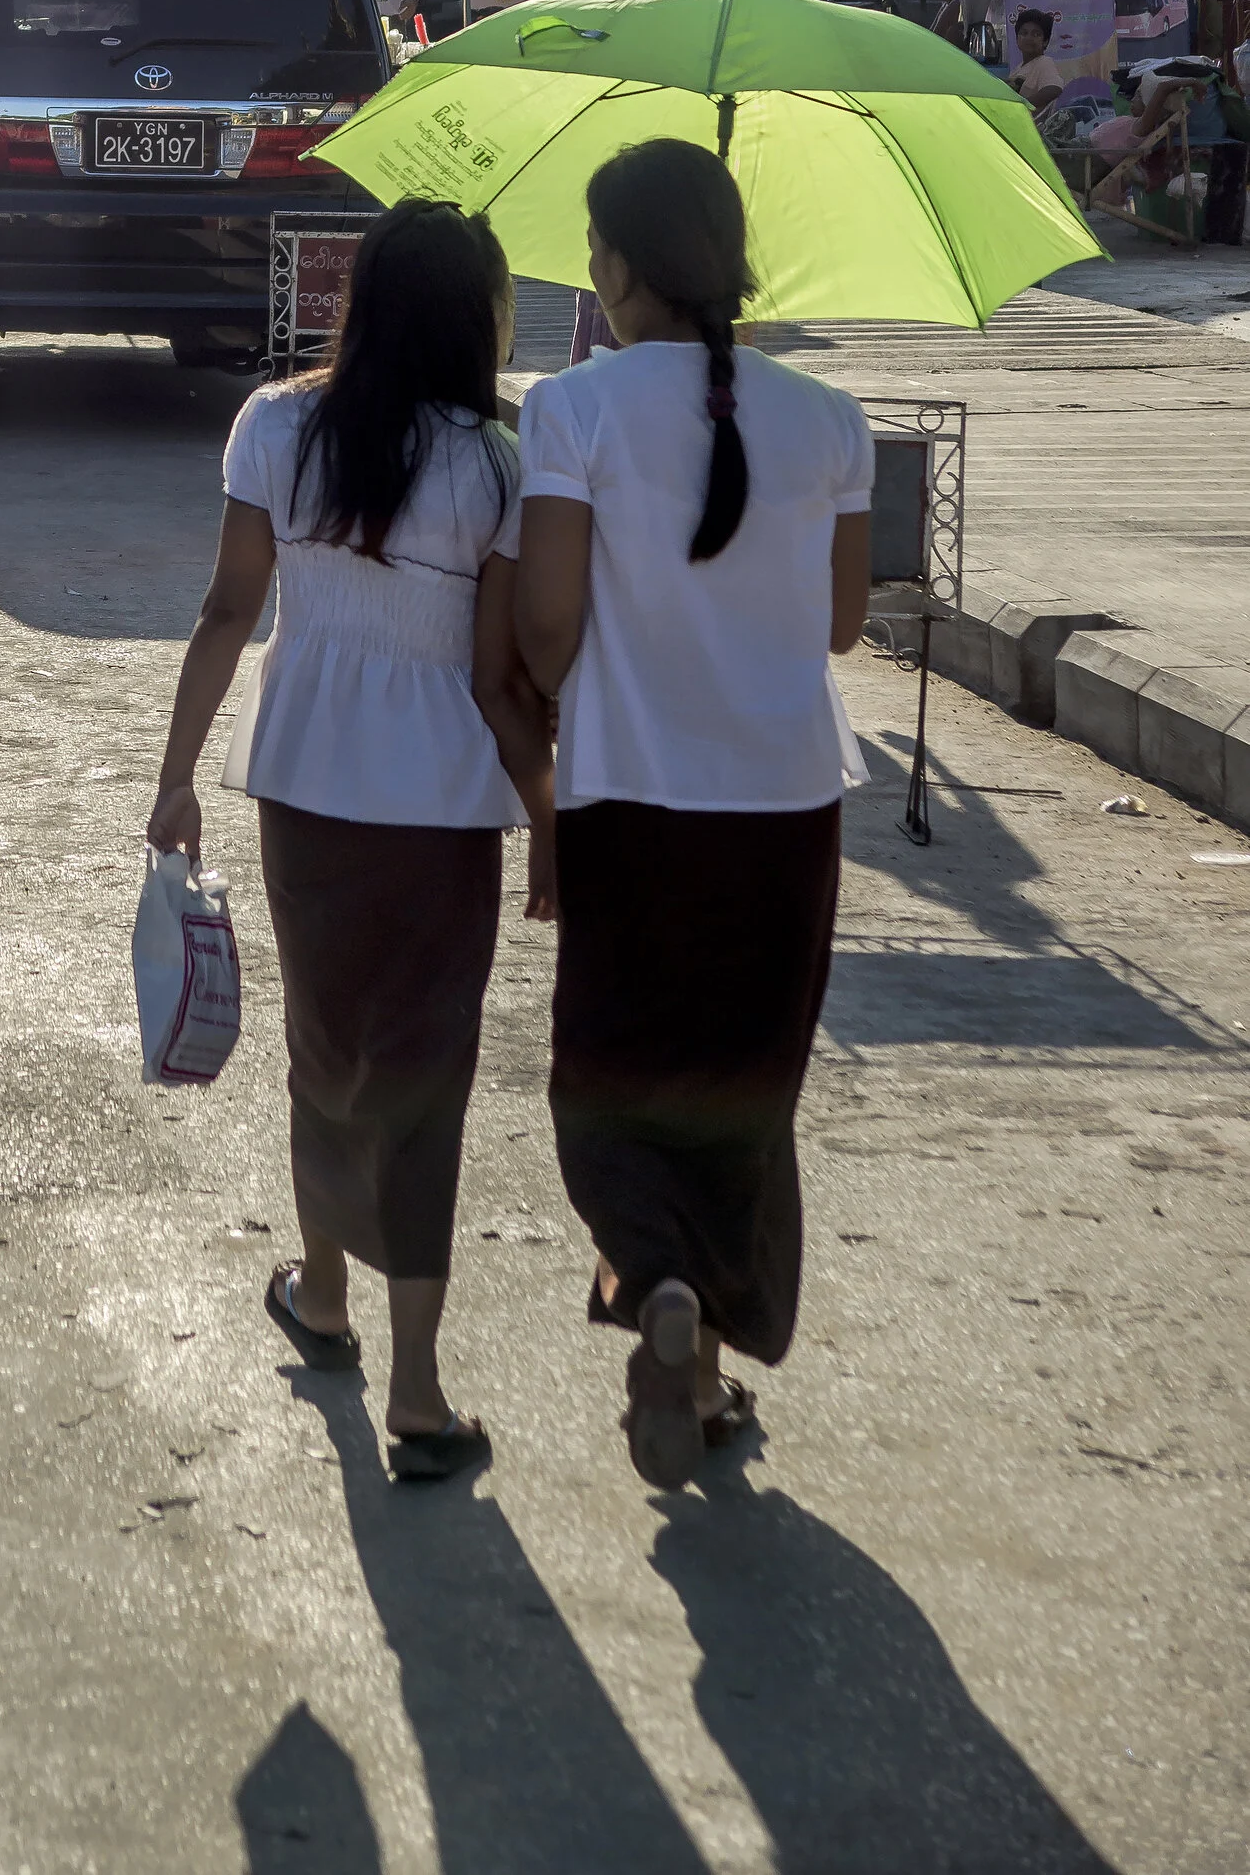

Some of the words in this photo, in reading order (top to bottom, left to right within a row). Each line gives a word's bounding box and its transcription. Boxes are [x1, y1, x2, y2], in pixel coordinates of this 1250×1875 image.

[248, 91, 320, 100] ALPHARD
[133, 122, 169, 136] YGN
[102, 135, 197, 164] 2K-3197
